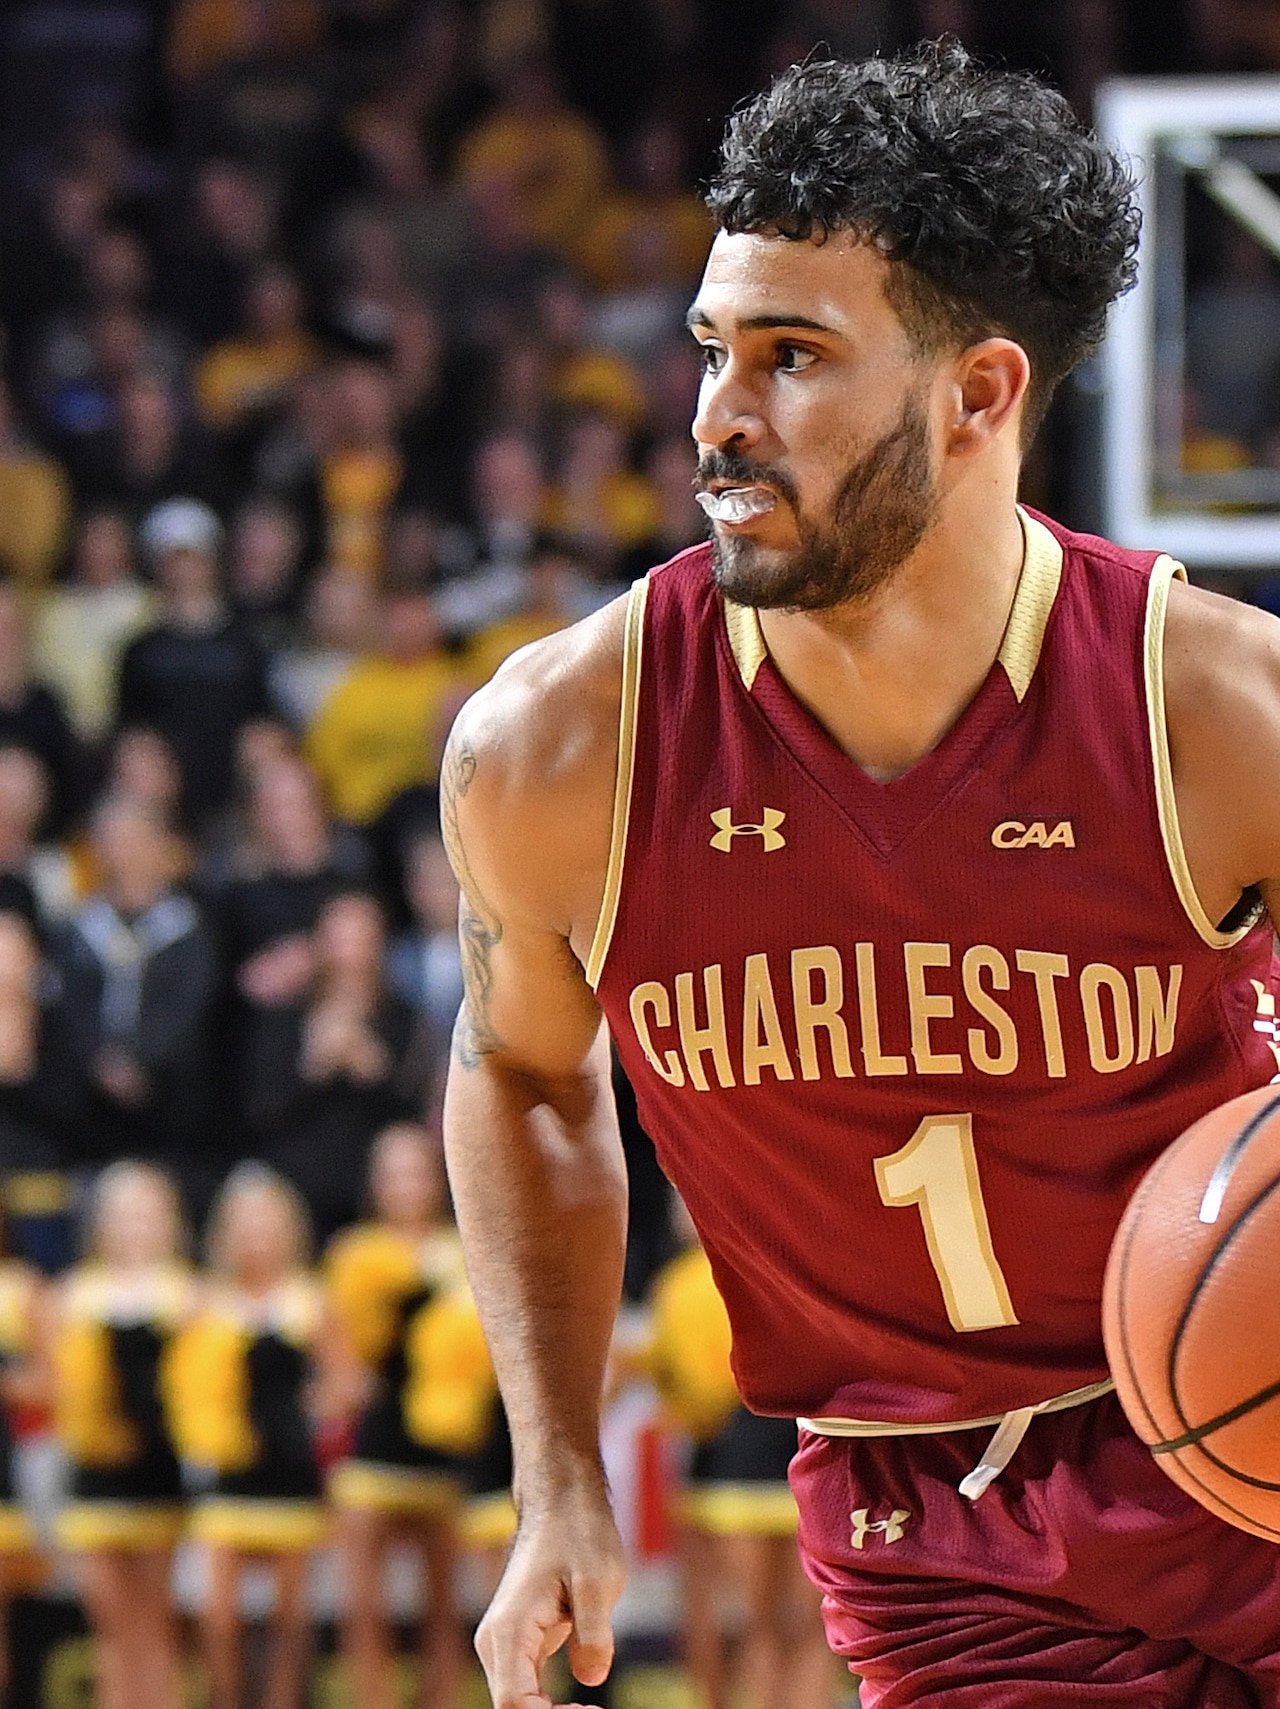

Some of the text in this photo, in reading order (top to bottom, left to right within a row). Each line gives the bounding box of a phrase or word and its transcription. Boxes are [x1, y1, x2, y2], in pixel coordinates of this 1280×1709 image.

[991, 821, 1076, 848] CAA
[629, 942, 1183, 1091] CHARLESTON
[873, 1112, 1021, 1333] 1
